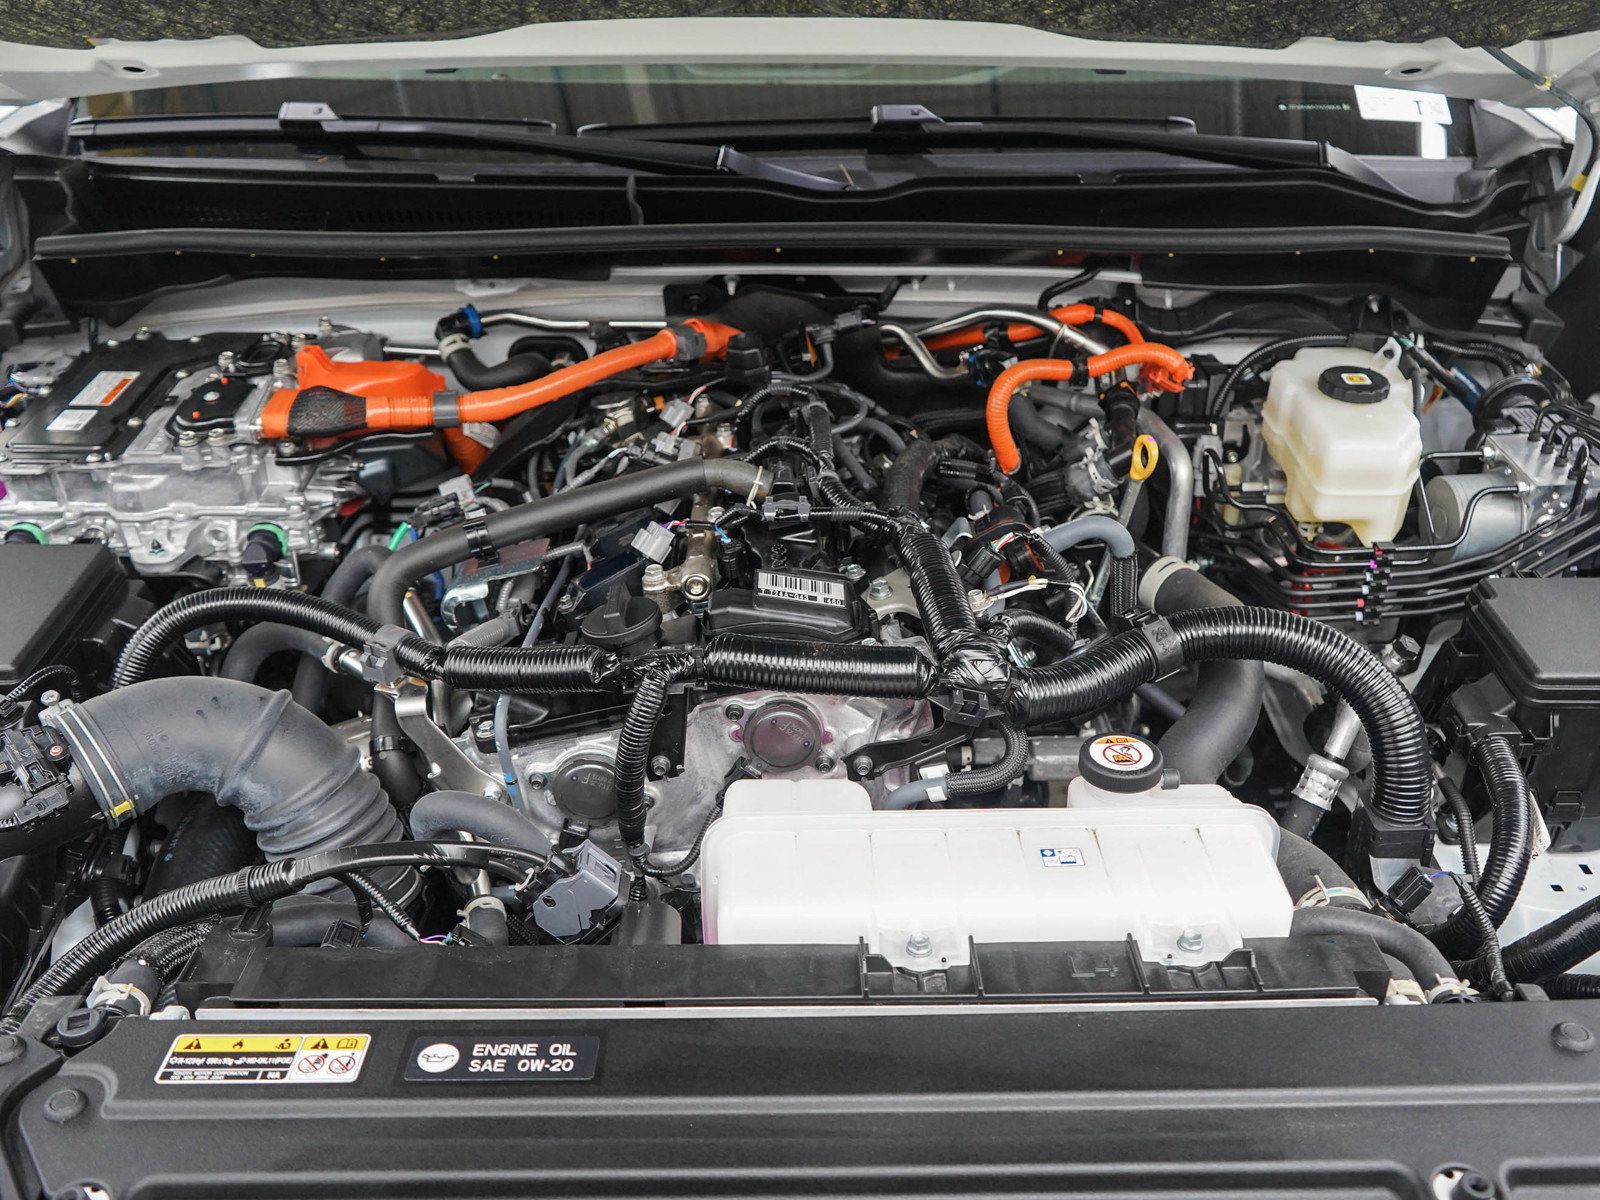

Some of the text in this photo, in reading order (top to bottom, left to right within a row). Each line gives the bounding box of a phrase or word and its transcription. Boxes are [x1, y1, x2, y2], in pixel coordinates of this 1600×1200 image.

[472, 1043, 577, 1056] ENGINE OIL
[468, 1059, 574, 1072] SAE 0W-20
